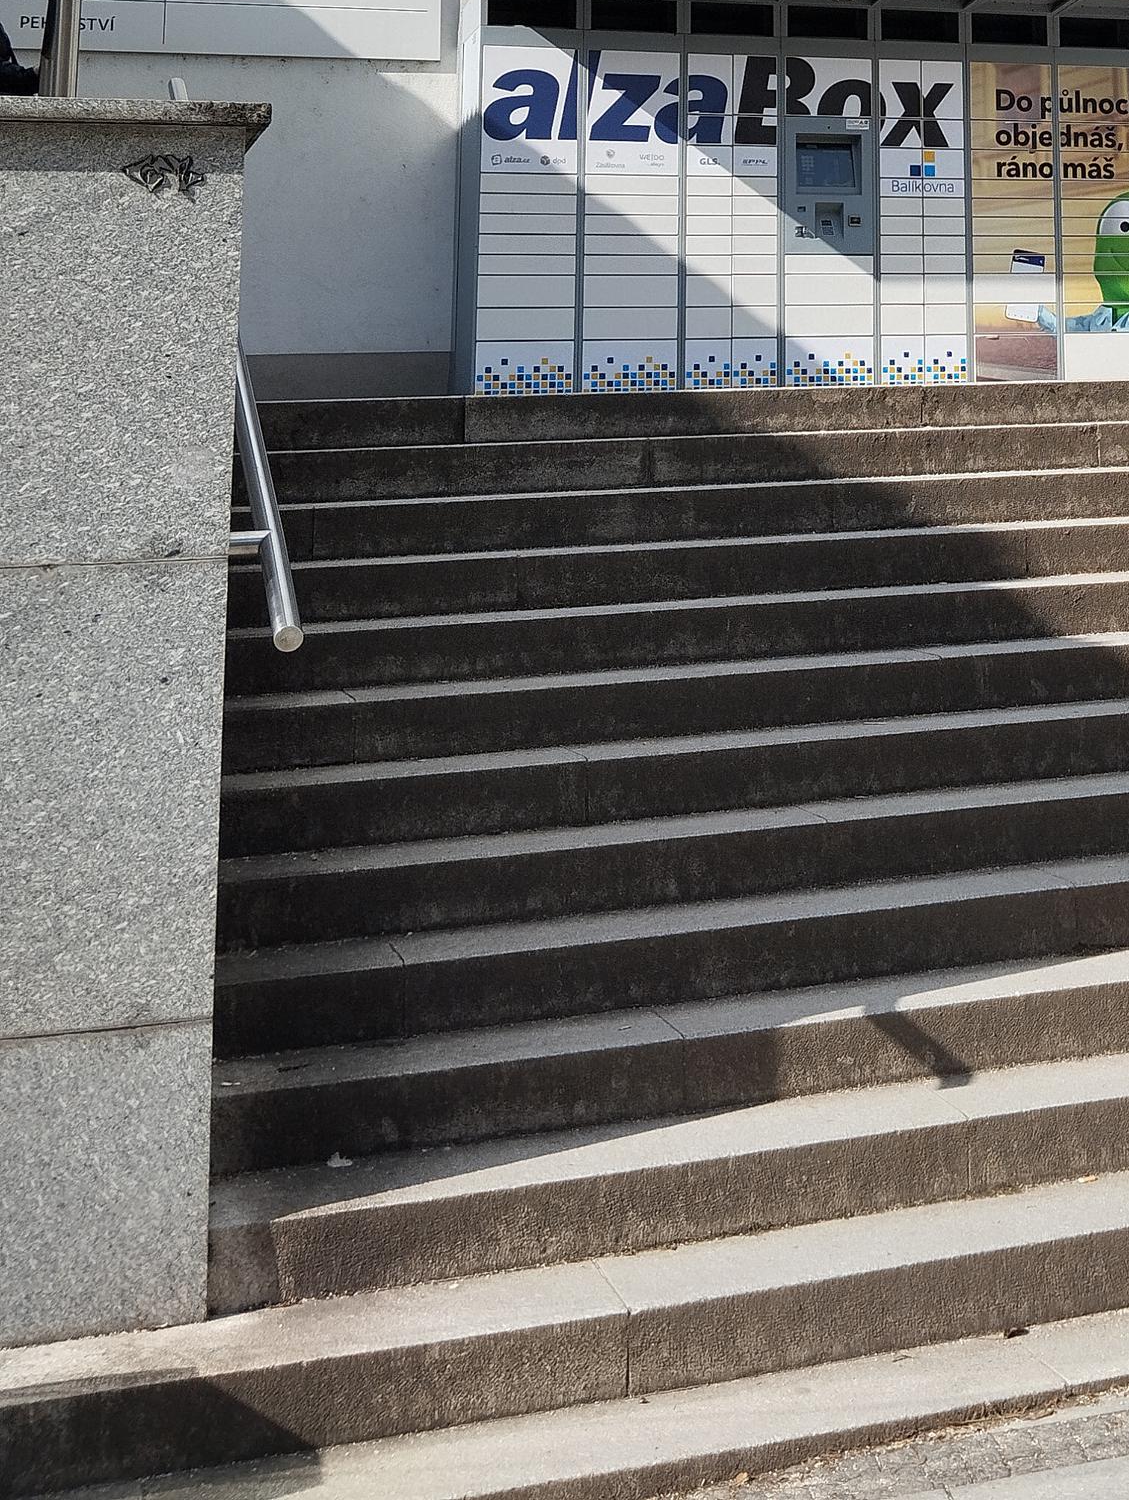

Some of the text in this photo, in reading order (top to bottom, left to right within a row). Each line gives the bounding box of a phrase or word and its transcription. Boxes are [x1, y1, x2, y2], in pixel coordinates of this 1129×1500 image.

[483, 49, 955, 148] alzaBox
[995, 88, 1033, 112] Do
[995, 123, 1124, 153] objednáš,
[995, 158, 1116, 180] ráno máš
[891, 179, 955, 194] Balíkovna
